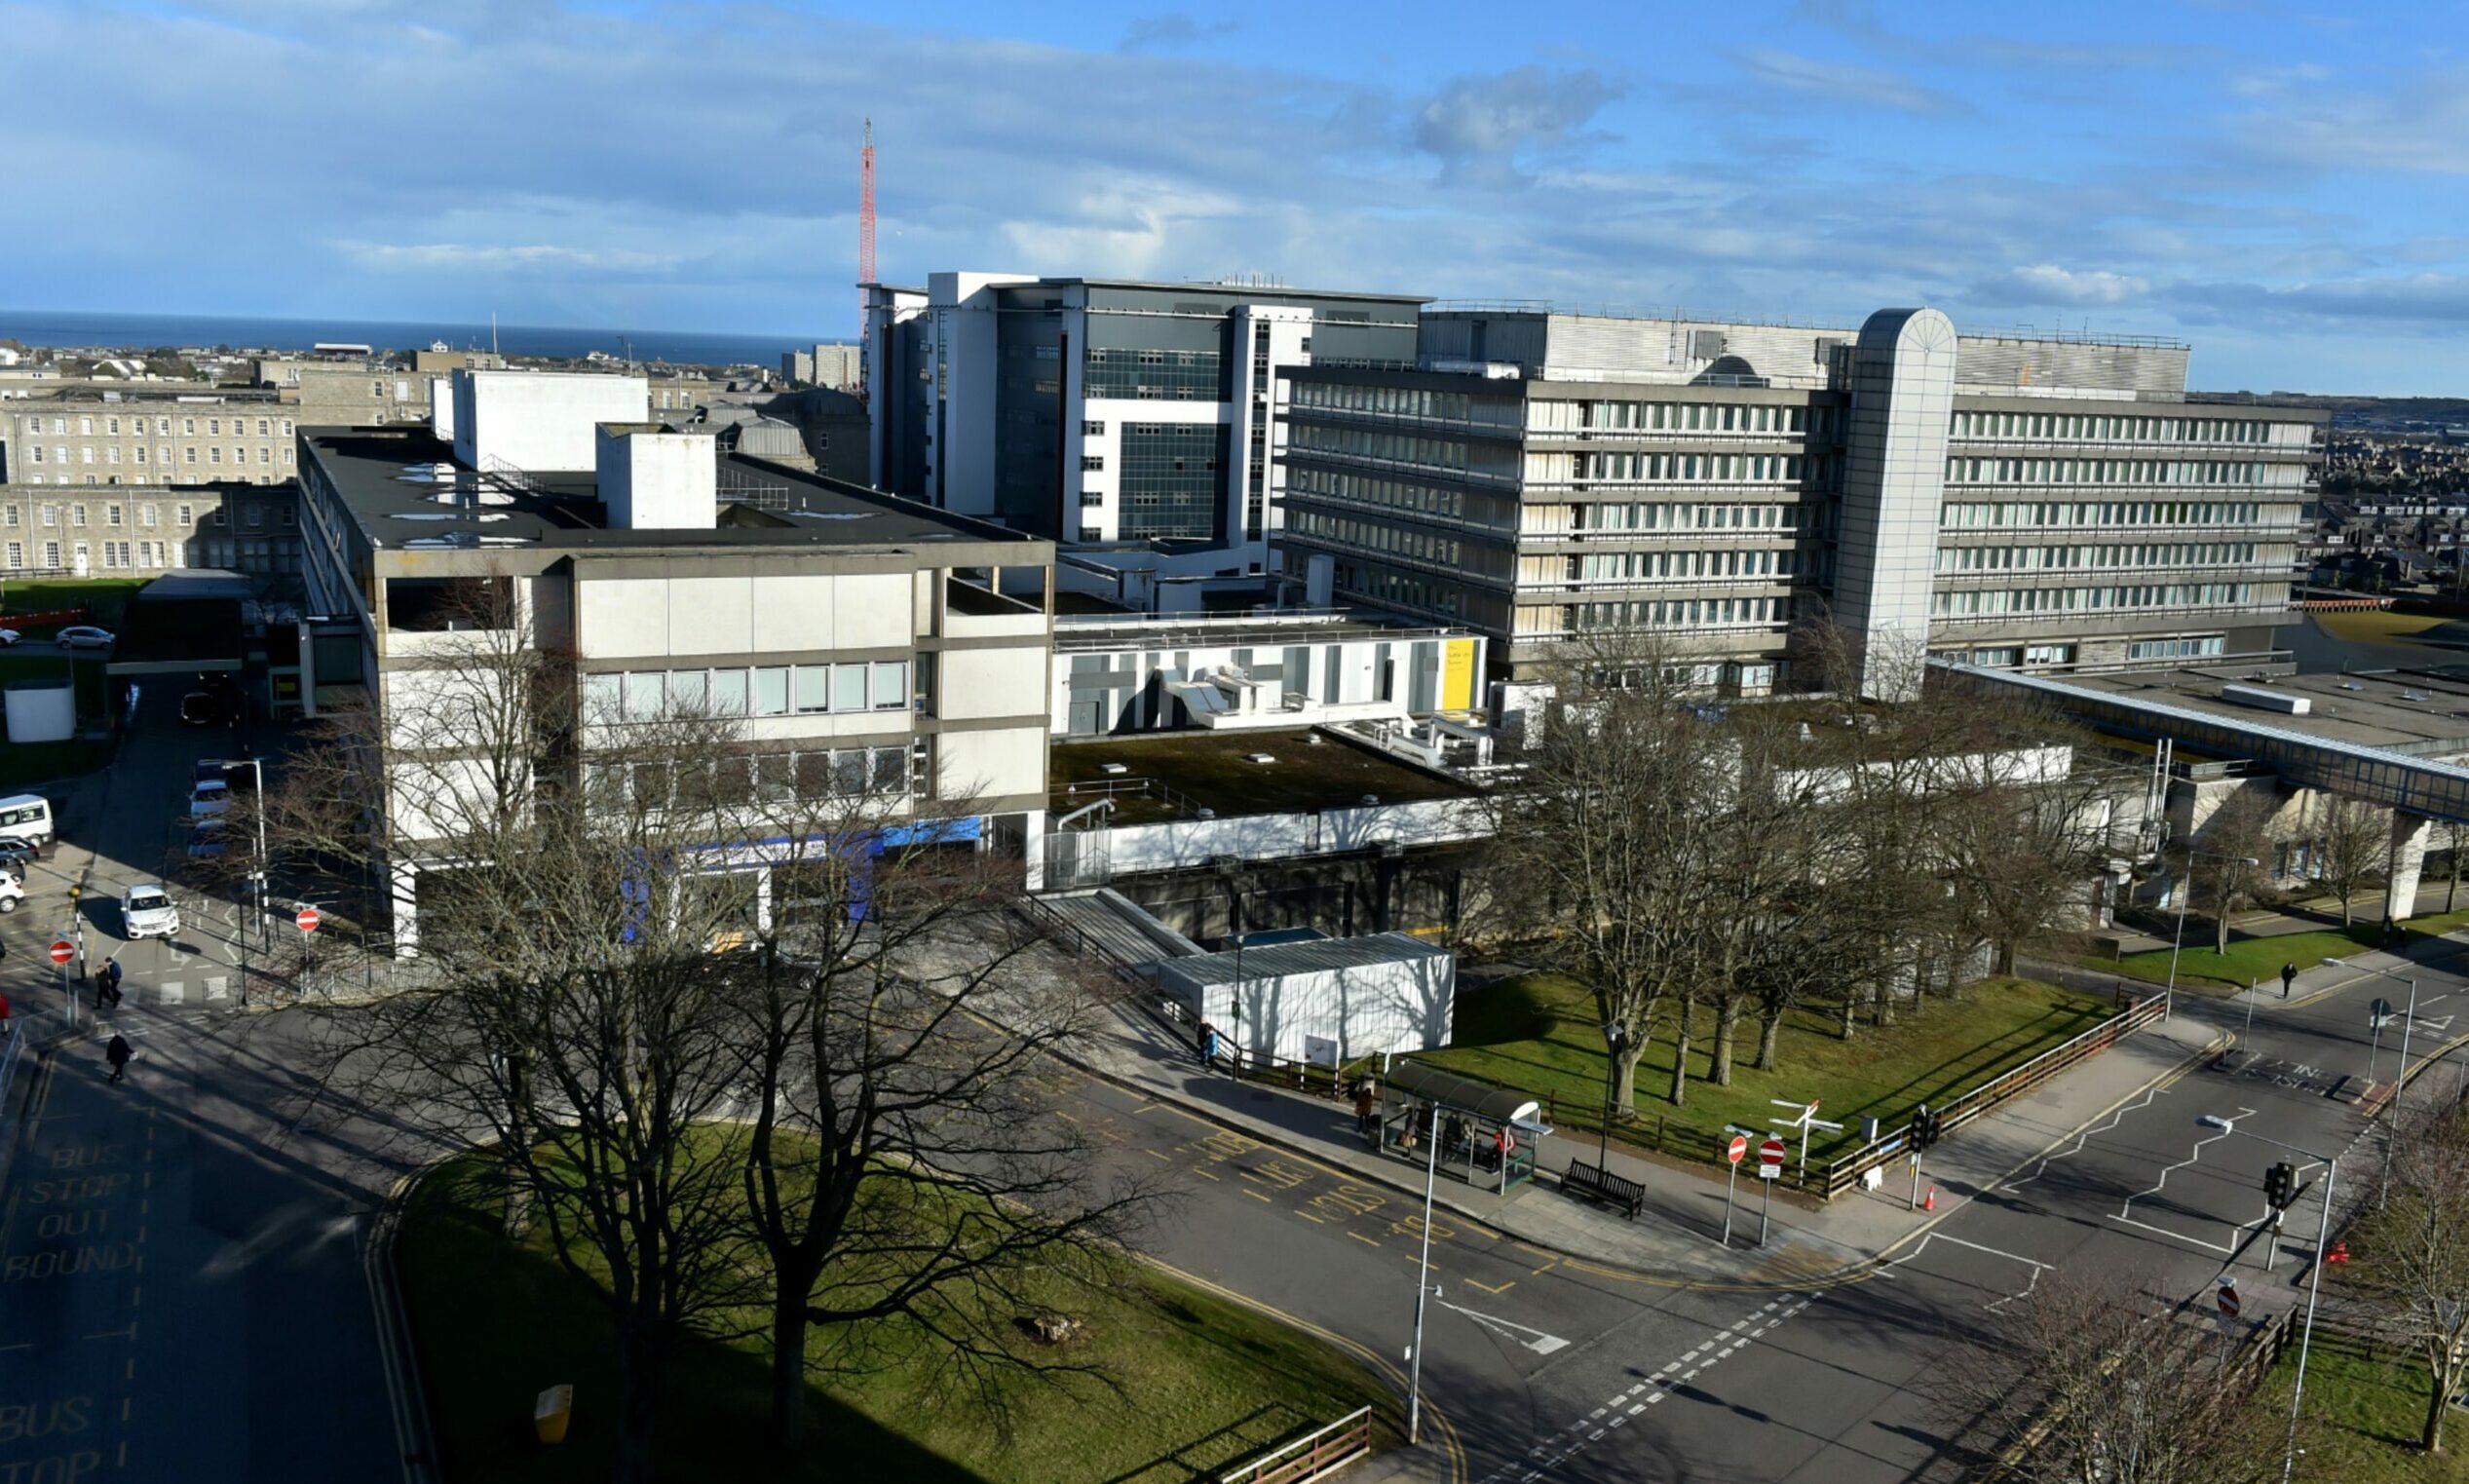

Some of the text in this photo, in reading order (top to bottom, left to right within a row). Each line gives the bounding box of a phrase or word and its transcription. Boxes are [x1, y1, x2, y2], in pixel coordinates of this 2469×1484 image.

[52, 1143, 126, 1169] BUS
[28, 1172, 132, 1204] STOP
[37, 1207, 115, 1239] OUT
[1383, 1215, 1456, 1245] BU
[3, 1240, 136, 1283] BOUND
[0, 1395, 93, 1442] BUS
